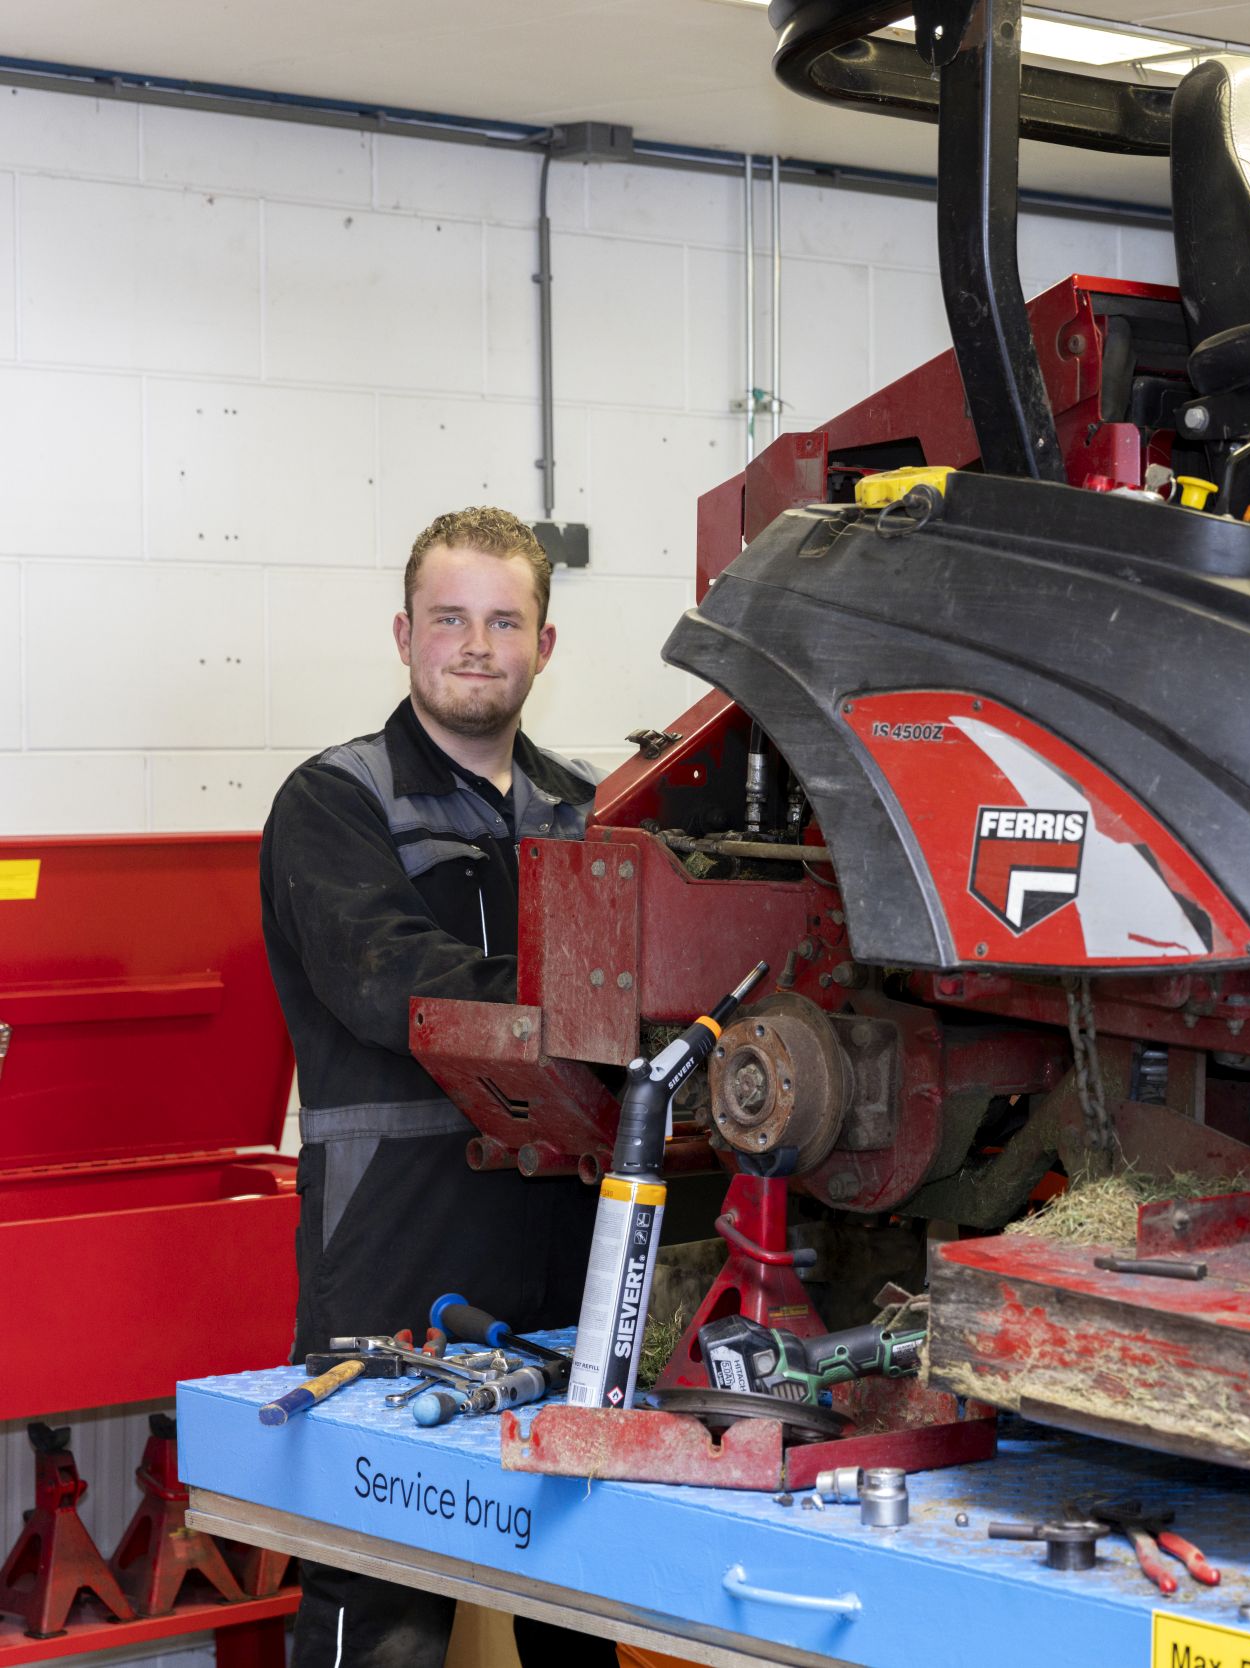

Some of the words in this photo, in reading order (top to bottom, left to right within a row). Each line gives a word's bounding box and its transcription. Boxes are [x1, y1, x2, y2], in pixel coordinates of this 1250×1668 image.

[874, 723, 889, 736] IS
[893, 724, 944, 741] 4500Z
[980, 811, 1084, 842] FERRIS
[668, 1056, 695, 1090] SIEVERT
[614, 1257, 645, 1359] SIEVERT
[733, 1360, 747, 1392] HITACH
[354, 1456, 456, 1519] Service
[464, 1479, 532, 1549] brug
